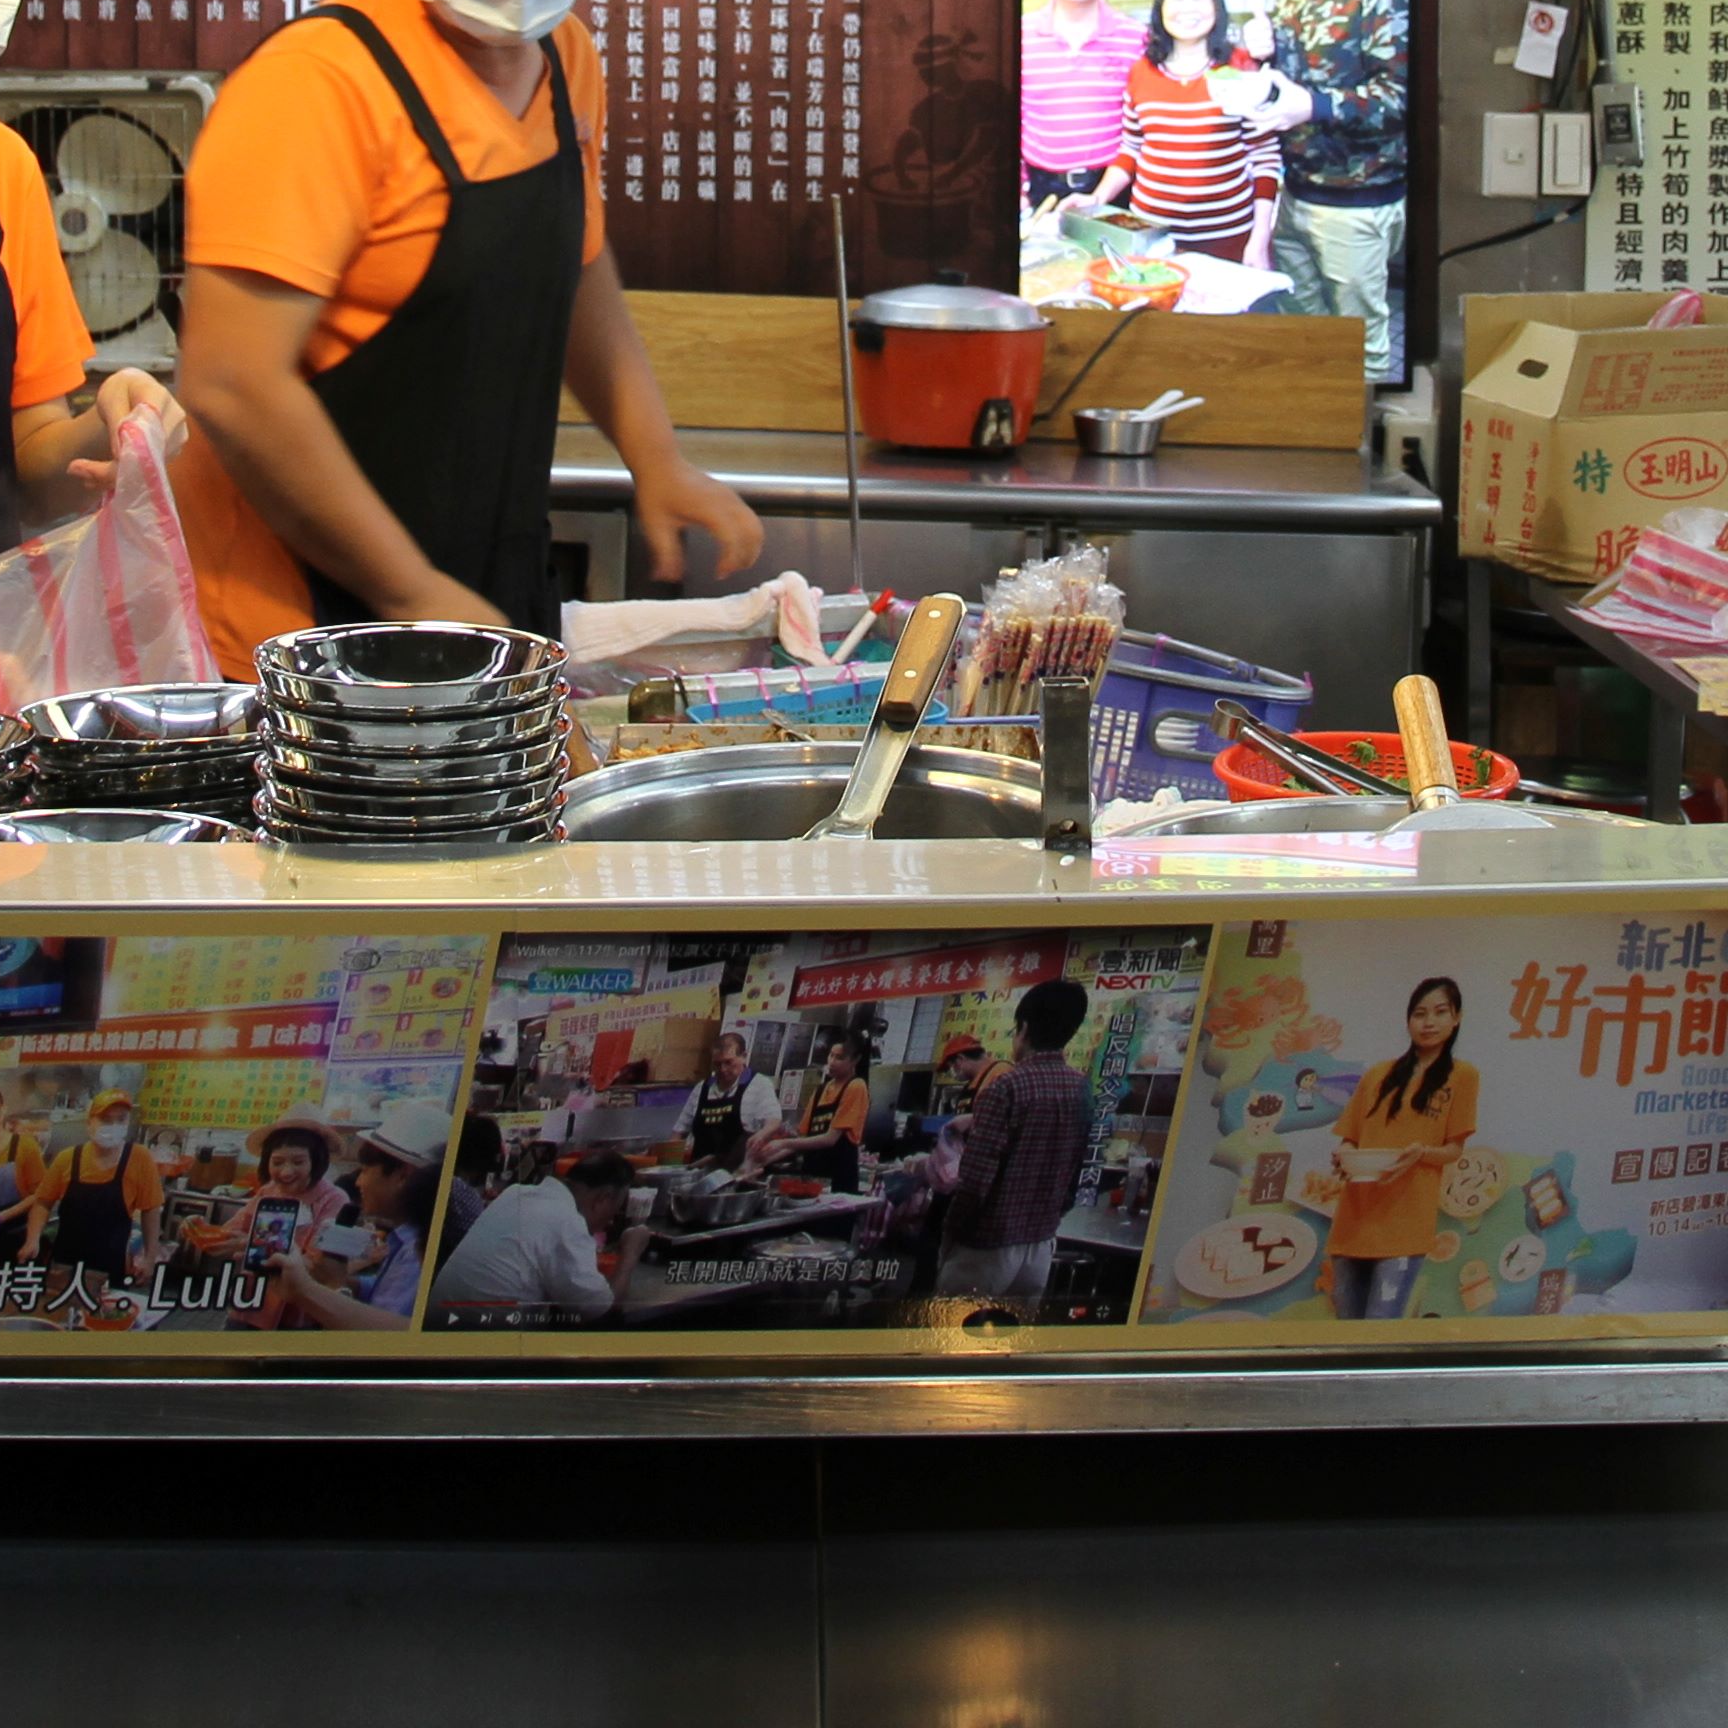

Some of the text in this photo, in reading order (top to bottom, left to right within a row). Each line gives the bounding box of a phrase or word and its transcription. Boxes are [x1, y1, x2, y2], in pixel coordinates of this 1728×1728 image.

[1573, 448, 1614, 495] 特
[1637, 450, 1720, 488] 玉明山
[1099, 942, 1183, 970] 壹新聞
[1616, 917, 1714, 972] 新北
[1684, 1110, 1728, 1136] Life
[667, 1257, 902, 1284] 張開眼睛就是肉羹啦
